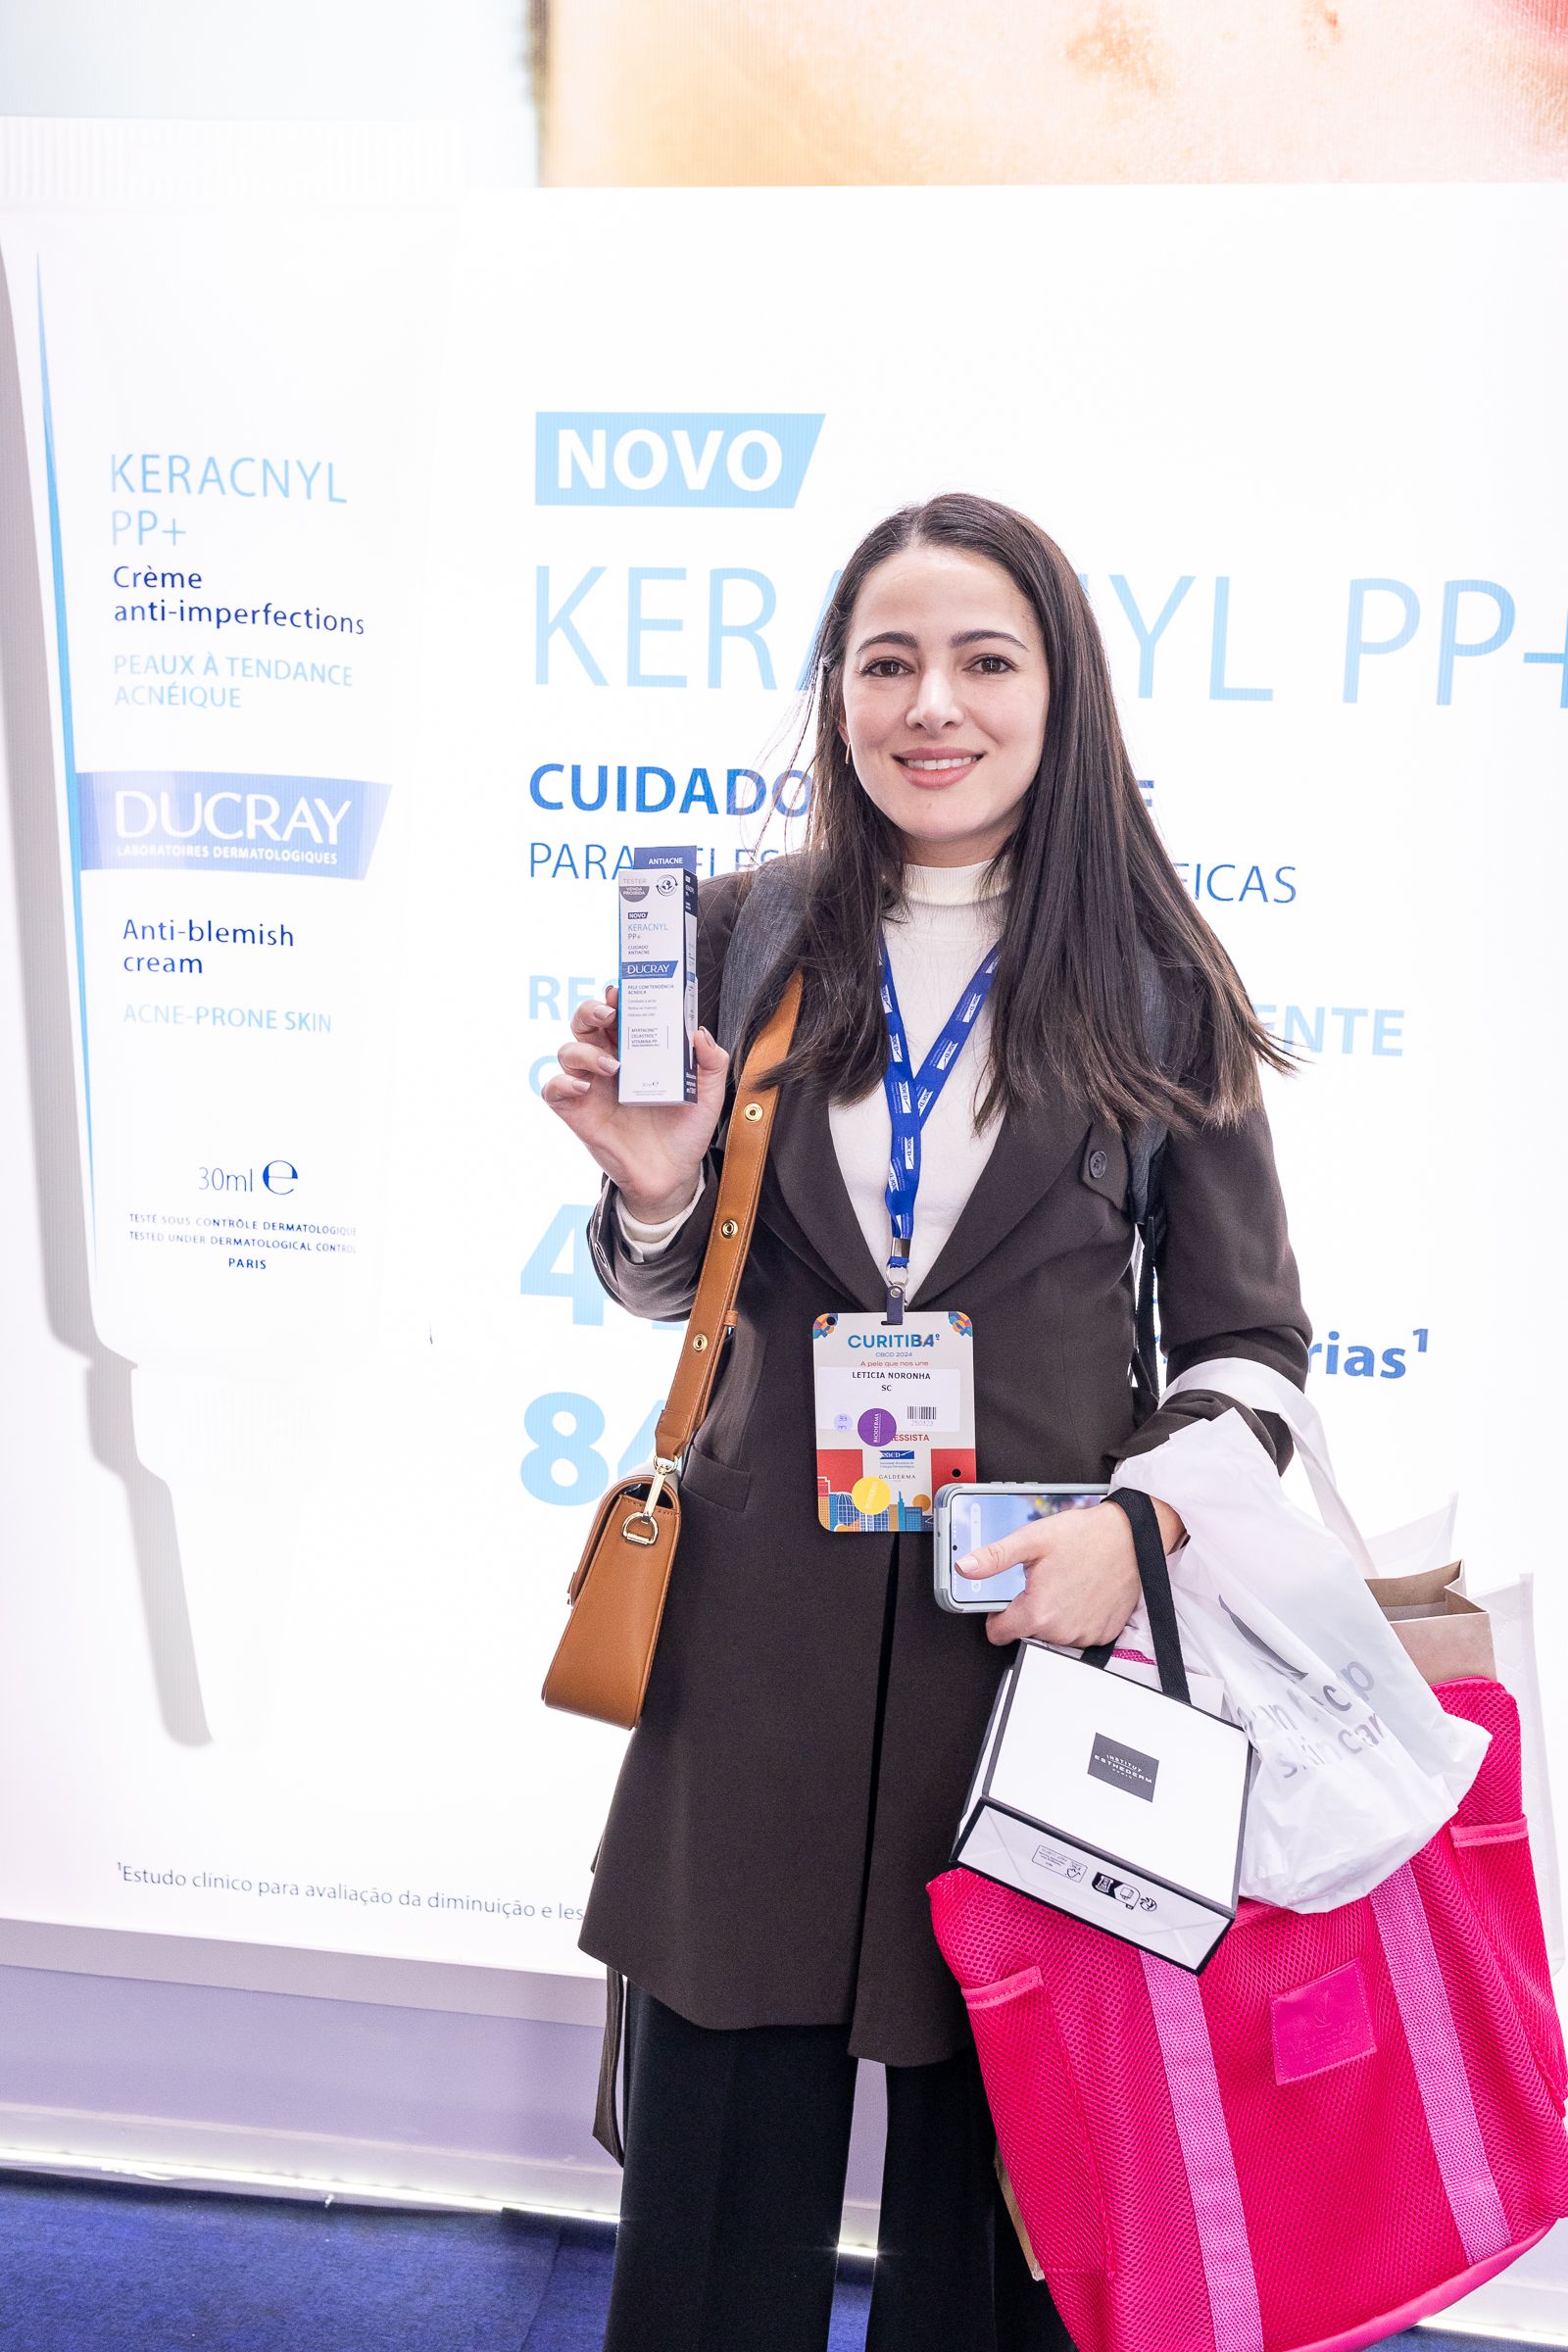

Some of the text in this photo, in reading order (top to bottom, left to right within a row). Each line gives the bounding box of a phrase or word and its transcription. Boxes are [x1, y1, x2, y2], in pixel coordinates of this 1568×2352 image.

[557, 428, 784, 492] NOVO
[110, 454, 347, 504] KERACNYL
[111, 510, 186, 547] PP+
[113, 564, 203, 589] Crème
[115, 600, 366, 635] anti-imperfections
[115, 650, 353, 687] PEAUX À TENDANCE
[115, 680, 242, 710] ACNÉIQUE
[529, 763, 812, 817] CUIDADO
[115, 790, 352, 845] DUCRAY
[117, 845, 338, 865] LABORATOIRES DERMATOLOGIQUES
[530, 842, 635, 880] PARA
[648, 857, 684, 865] ANTIACNE
[123, 919, 295, 948] Anti-blemish
[627, 923, 668, 932] KERACNYL
[123, 955, 203, 975] cream
[627, 963, 670, 974] DUCRAY
[123, 1004, 332, 1034] ACNE-PRONE SKIN
[198, 1166, 254, 1193] 30ml
[162, 1215, 191, 1226] SOUS
[195, 1217, 259, 1231] CONTRÔLE
[263, 1220, 358, 1237] DERMATOLOGIQUE
[129, 1231, 358, 1254] TESTED UNDER DERMATOLOGICAL CONTROL
[228, 1257, 267, 1269] PARIS
[852, 1371, 931, 1380] LETICIA NORONHA
[881, 1384, 893, 1393] SC
[1094, 1754, 1152, 1784] ESTHEDERM
[1105, 1754, 1143, 1773] INSTITUT
[259, 1879, 300, 1896] para
[305, 1883, 393, 1906] avaliação
[399, 1889, 421, 1908] da
[428, 1891, 535, 1919] diminuição
[541, 1906, 552, 1919] e
